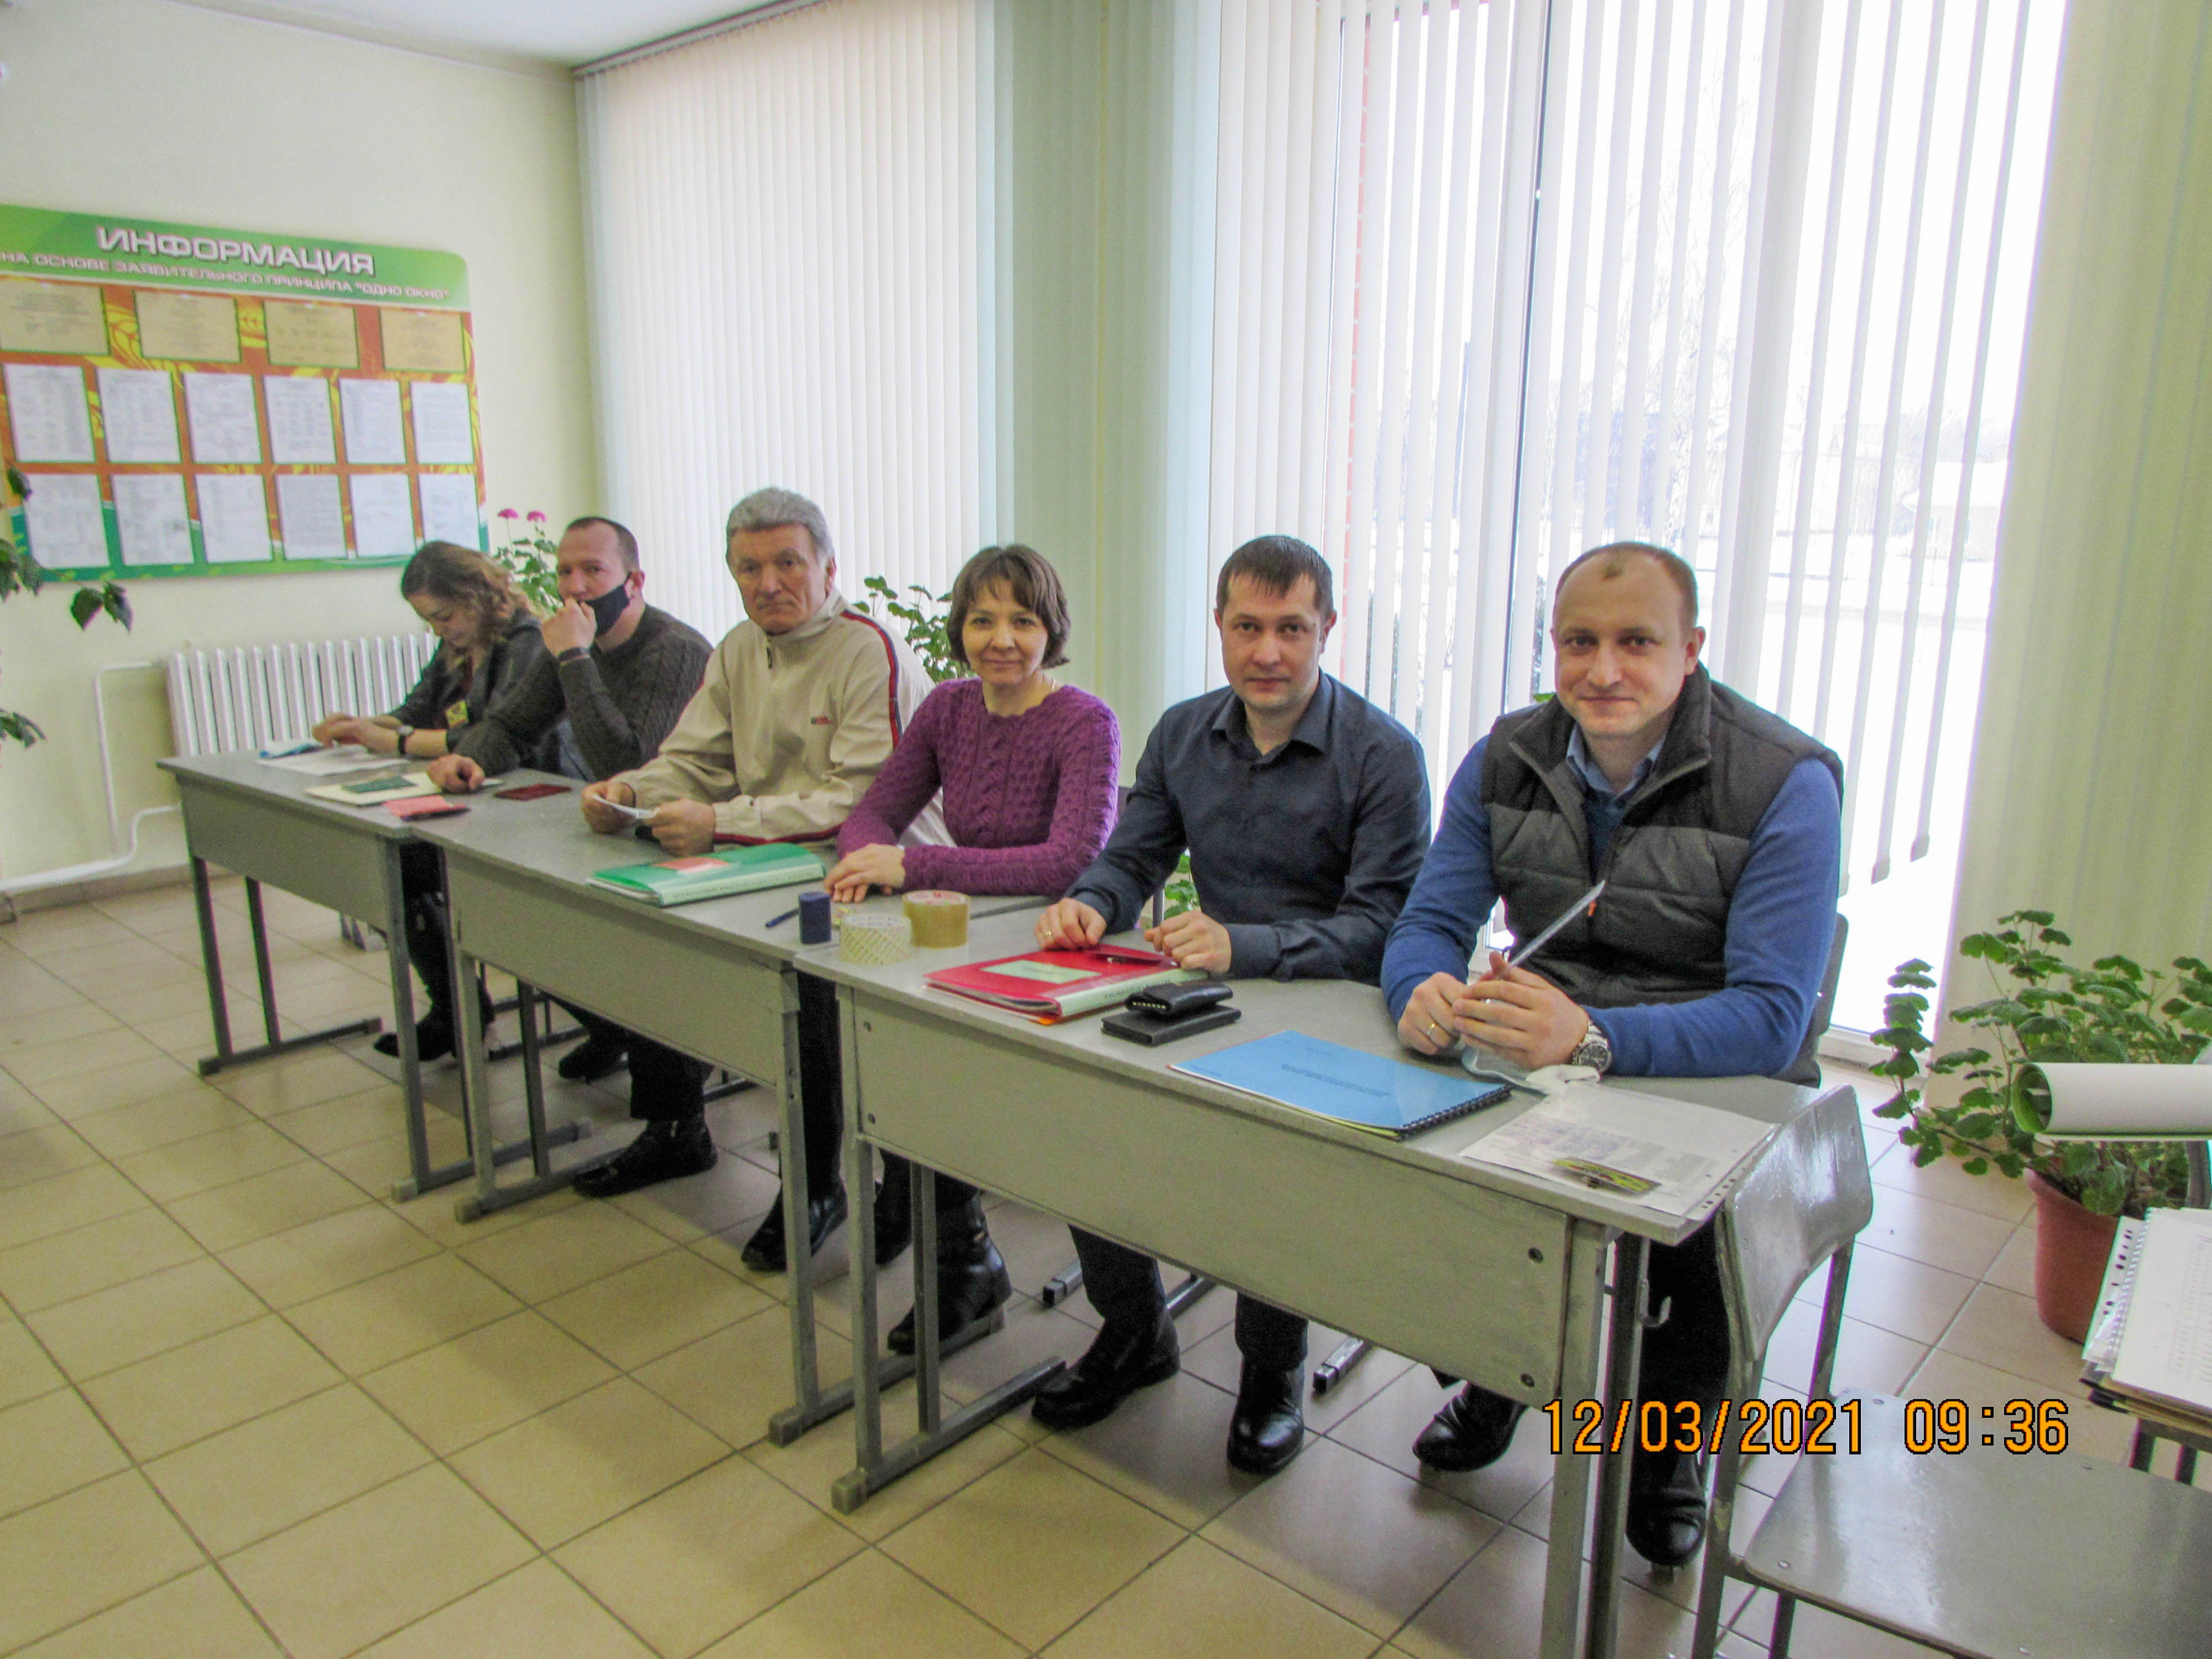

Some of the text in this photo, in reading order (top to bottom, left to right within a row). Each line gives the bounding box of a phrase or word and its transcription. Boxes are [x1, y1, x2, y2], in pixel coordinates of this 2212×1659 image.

[1, 251, 30, 265] НА
[33, 253, 110, 272] ОСНОВЕ
[113, 260, 264, 286] ЗАЯВИТЕЛЬНОГО
[266, 274, 352, 293] ПРИНЦИПА
[96, 226, 375, 276] ИНФОРМАЦИЯ
